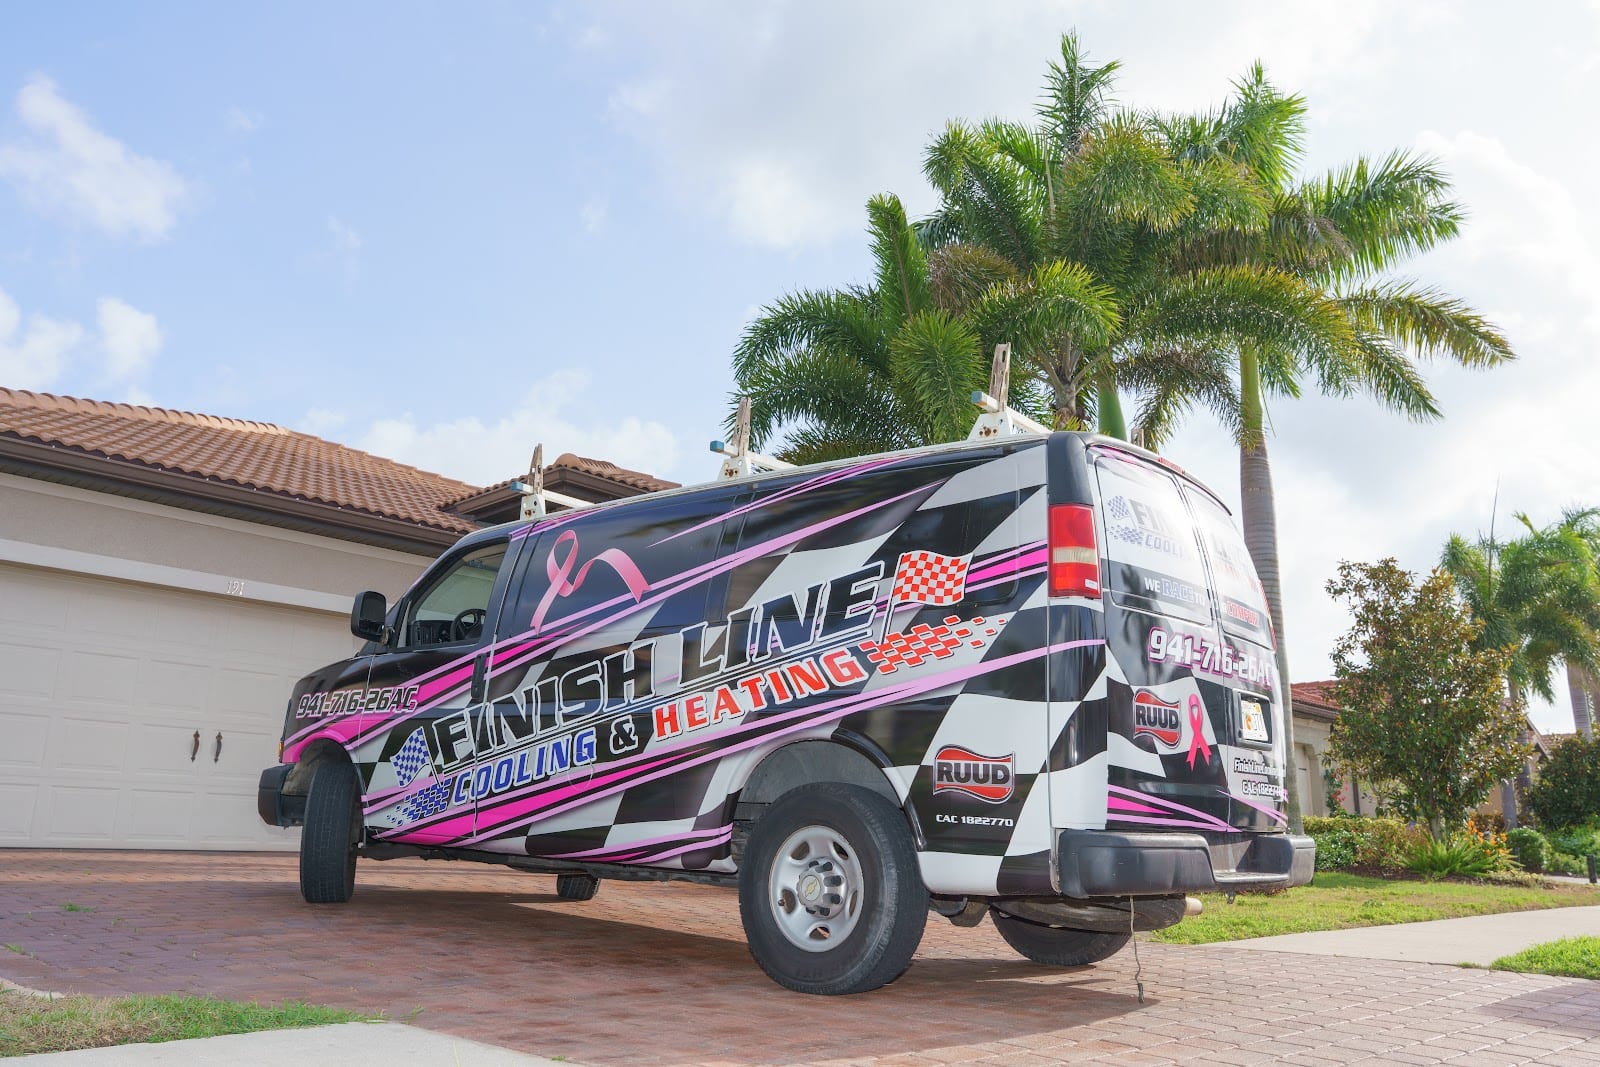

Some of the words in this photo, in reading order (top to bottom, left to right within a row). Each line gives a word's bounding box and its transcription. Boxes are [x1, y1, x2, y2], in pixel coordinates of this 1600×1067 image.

[1144, 577, 1160, 593] WE
[1161, 578, 1194, 603] RACE
[432, 640, 657, 768] FINISH
[679, 560, 884, 687] LINE
[296, 685, 419, 718] 941-716-26AC
[453, 726, 597, 805] COOLING
[610, 715, 638, 755] &
[653, 646, 868, 740] HEATING
[1135, 704, 1179, 730] RUUD
[937, 762, 1010, 785] RUUD
[1242, 780, 1257, 795] CAC
[936, 814, 959, 824] CAC
[961, 816, 1014, 827] 1822770
